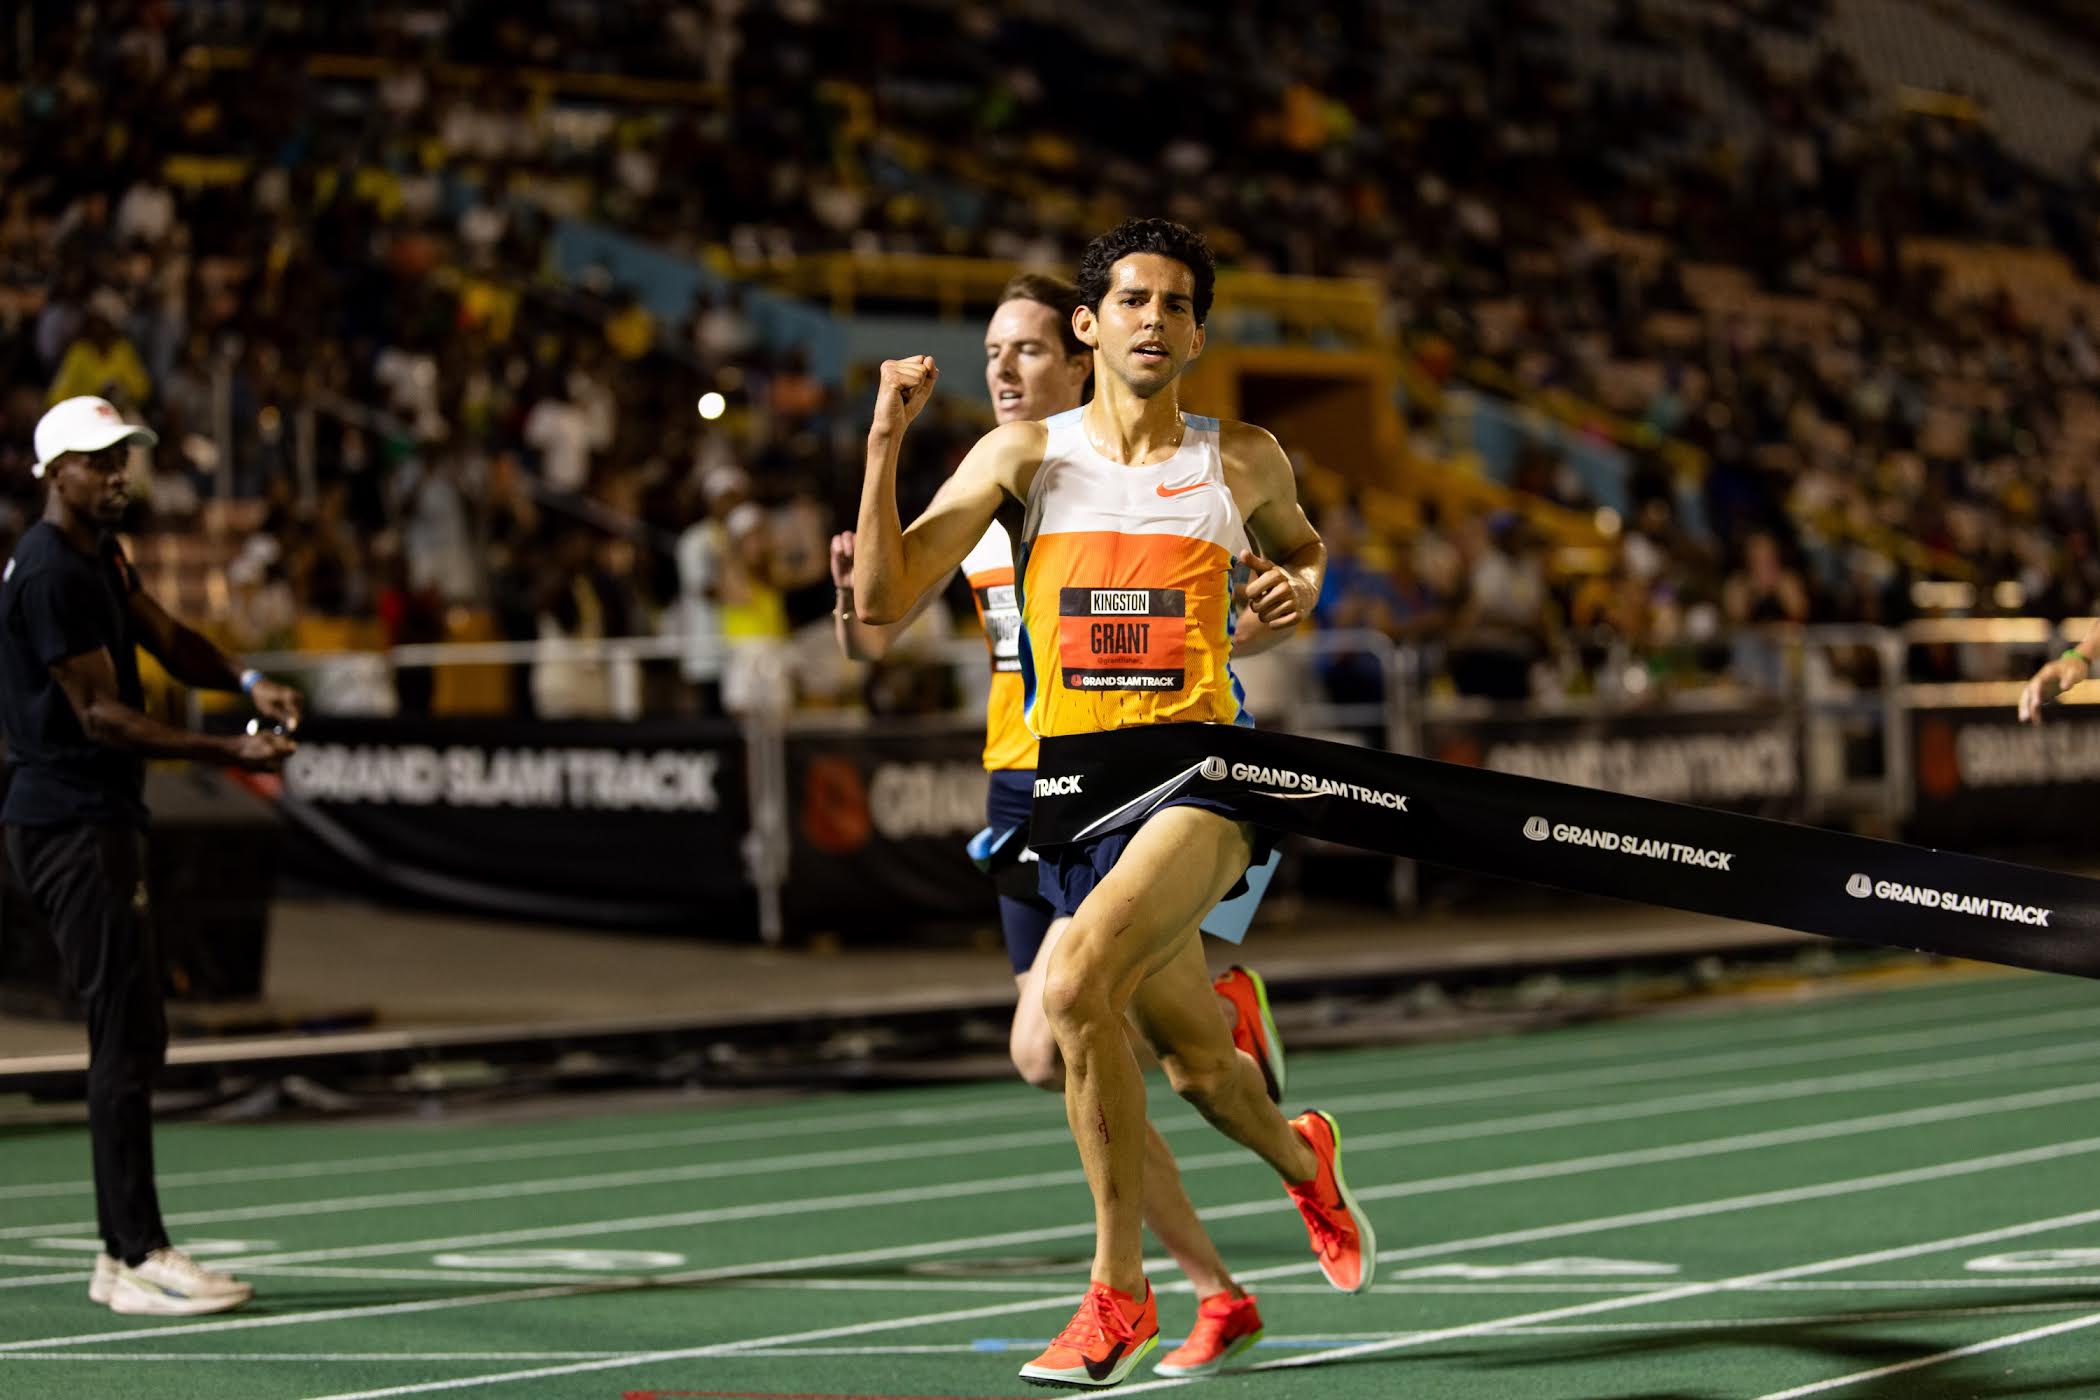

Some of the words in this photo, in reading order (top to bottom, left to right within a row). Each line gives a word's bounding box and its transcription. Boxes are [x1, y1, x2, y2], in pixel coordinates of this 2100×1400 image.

[1093, 593, 1146, 611] KINGSTON
[1090, 623, 1150, 654] GRANT
[1082, 676, 1116, 687] GRAND
[1117, 676, 1142, 687] SLAM
[1142, 677, 1174, 687] TRACK
[285, 743, 442, 803] GRAND
[443, 745, 563, 808] SLAM
[564, 748, 718, 811] TRACK
[1034, 775, 1083, 798] TRACK
[1231, 762, 1300, 789] GRAND
[1300, 774, 1349, 798] SLAM
[1348, 784, 1409, 812] TRACK
[1552, 823, 1620, 851] GRAND
[1620, 835, 1670, 860] SLAM
[1671, 843, 1732, 871] TRACK
[1874, 880, 1941, 908] GRAND
[1941, 891, 1989, 917] SLAM
[1989, 900, 2050, 927] TRACK
